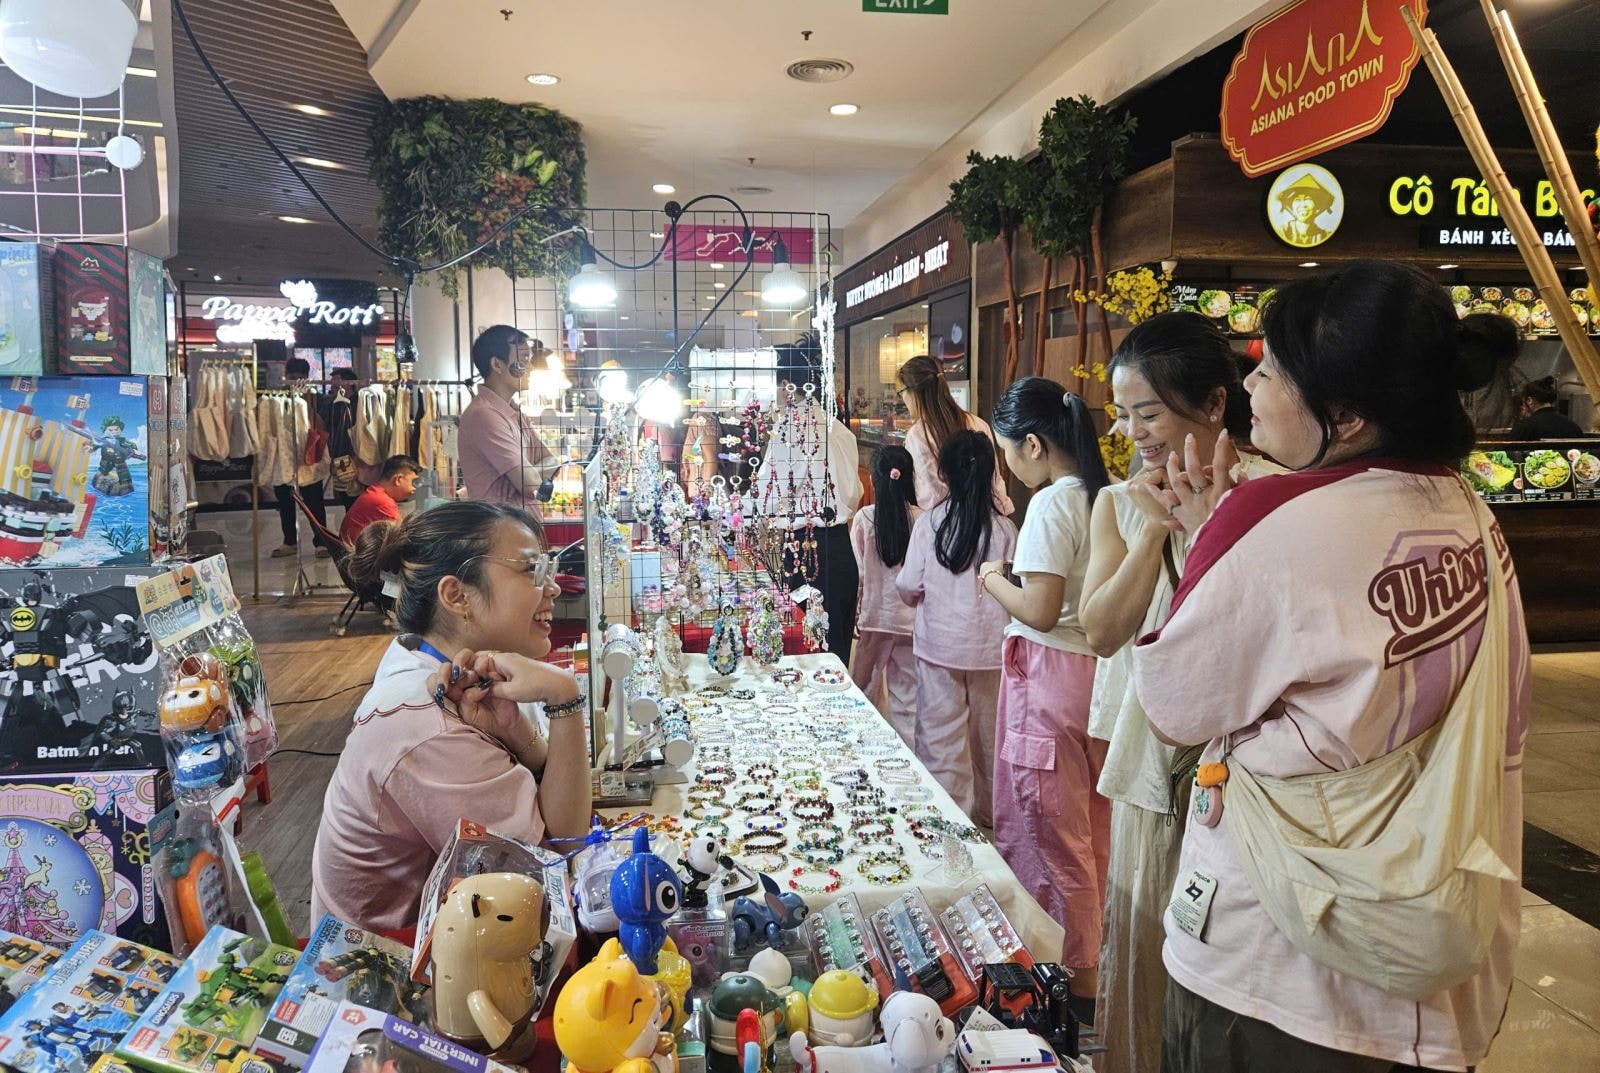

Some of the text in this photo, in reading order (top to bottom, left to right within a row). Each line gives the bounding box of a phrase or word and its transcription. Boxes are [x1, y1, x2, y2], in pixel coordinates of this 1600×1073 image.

[1250, 54, 1384, 136] ASIANA FOOD TOWN
[1389, 174, 1434, 216] Cô
[1439, 227, 1484, 245] BÁNH
[202, 297, 377, 328] Pappa Roti
[37, 745, 99, 759] Batmn
[318, 918, 337, 941] SERIES
[393, 1022, 419, 1040] CAR
[421, 1035, 479, 1067] INERTIAL
